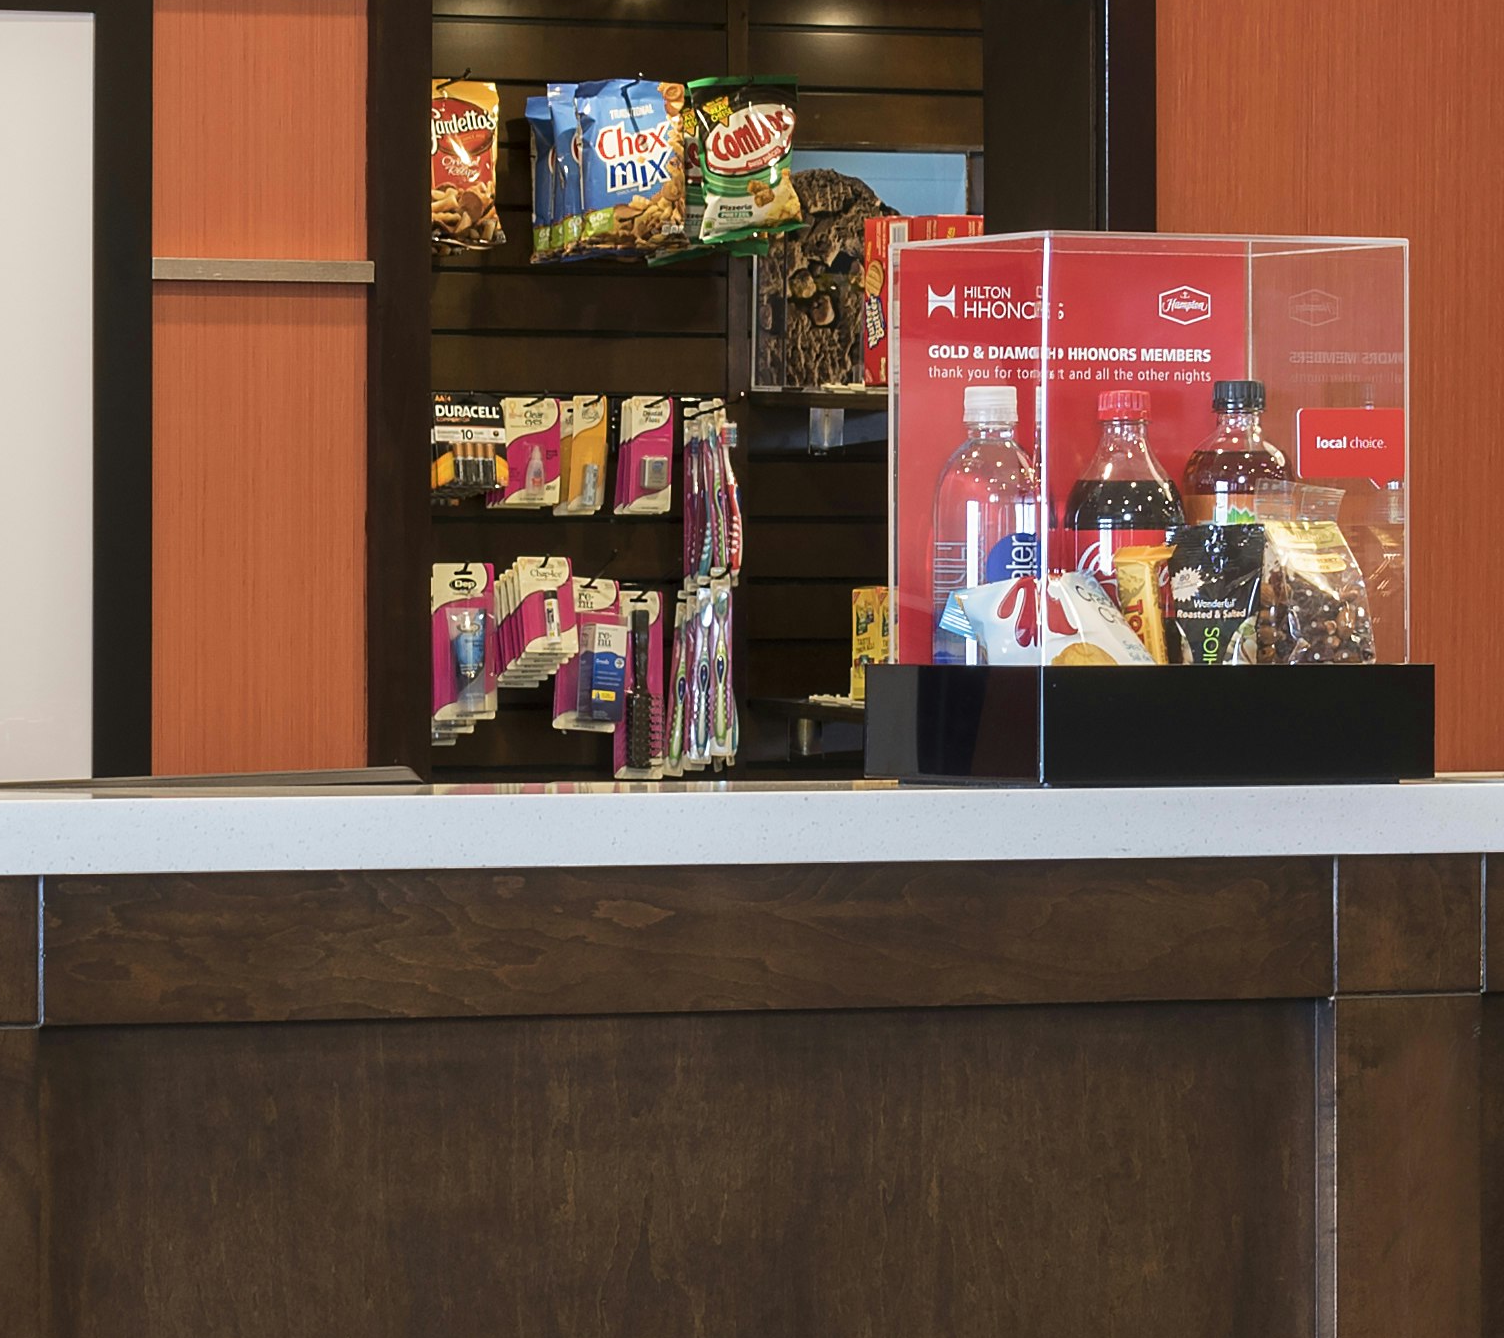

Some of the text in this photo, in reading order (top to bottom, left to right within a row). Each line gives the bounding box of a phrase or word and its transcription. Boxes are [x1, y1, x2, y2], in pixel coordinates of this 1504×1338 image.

[596, 124, 668, 160] Chex
[608, 151, 668, 188] mix
[963, 286, 1011, 299] HILTON
[1162, 297, 1208, 313] Hampton
[928, 345, 970, 360] GOLD
[973, 346, 985, 360] &
[1068, 347, 1137, 361] HHONORS
[1141, 349, 1212, 363] MEMBERS
[928, 366, 964, 379] thank
[968, 369, 991, 381] you
[994, 367, 1013, 379] for
[1069, 368, 1092, 380] and
[1095, 367, 1110, 380] all
[1114, 368, 1134, 381] the
[1137, 369, 1170, 382] other
[1174, 370, 1212, 383] nights
[435, 404, 499, 419] DURACELL
[523, 410, 544, 419] Clear
[460, 429, 474, 440] 10
[1316, 435, 1388, 449] local choice.
[1193, 598, 1236, 609] Wonderful
[1176, 608, 1247, 619] Roasted & Salted
